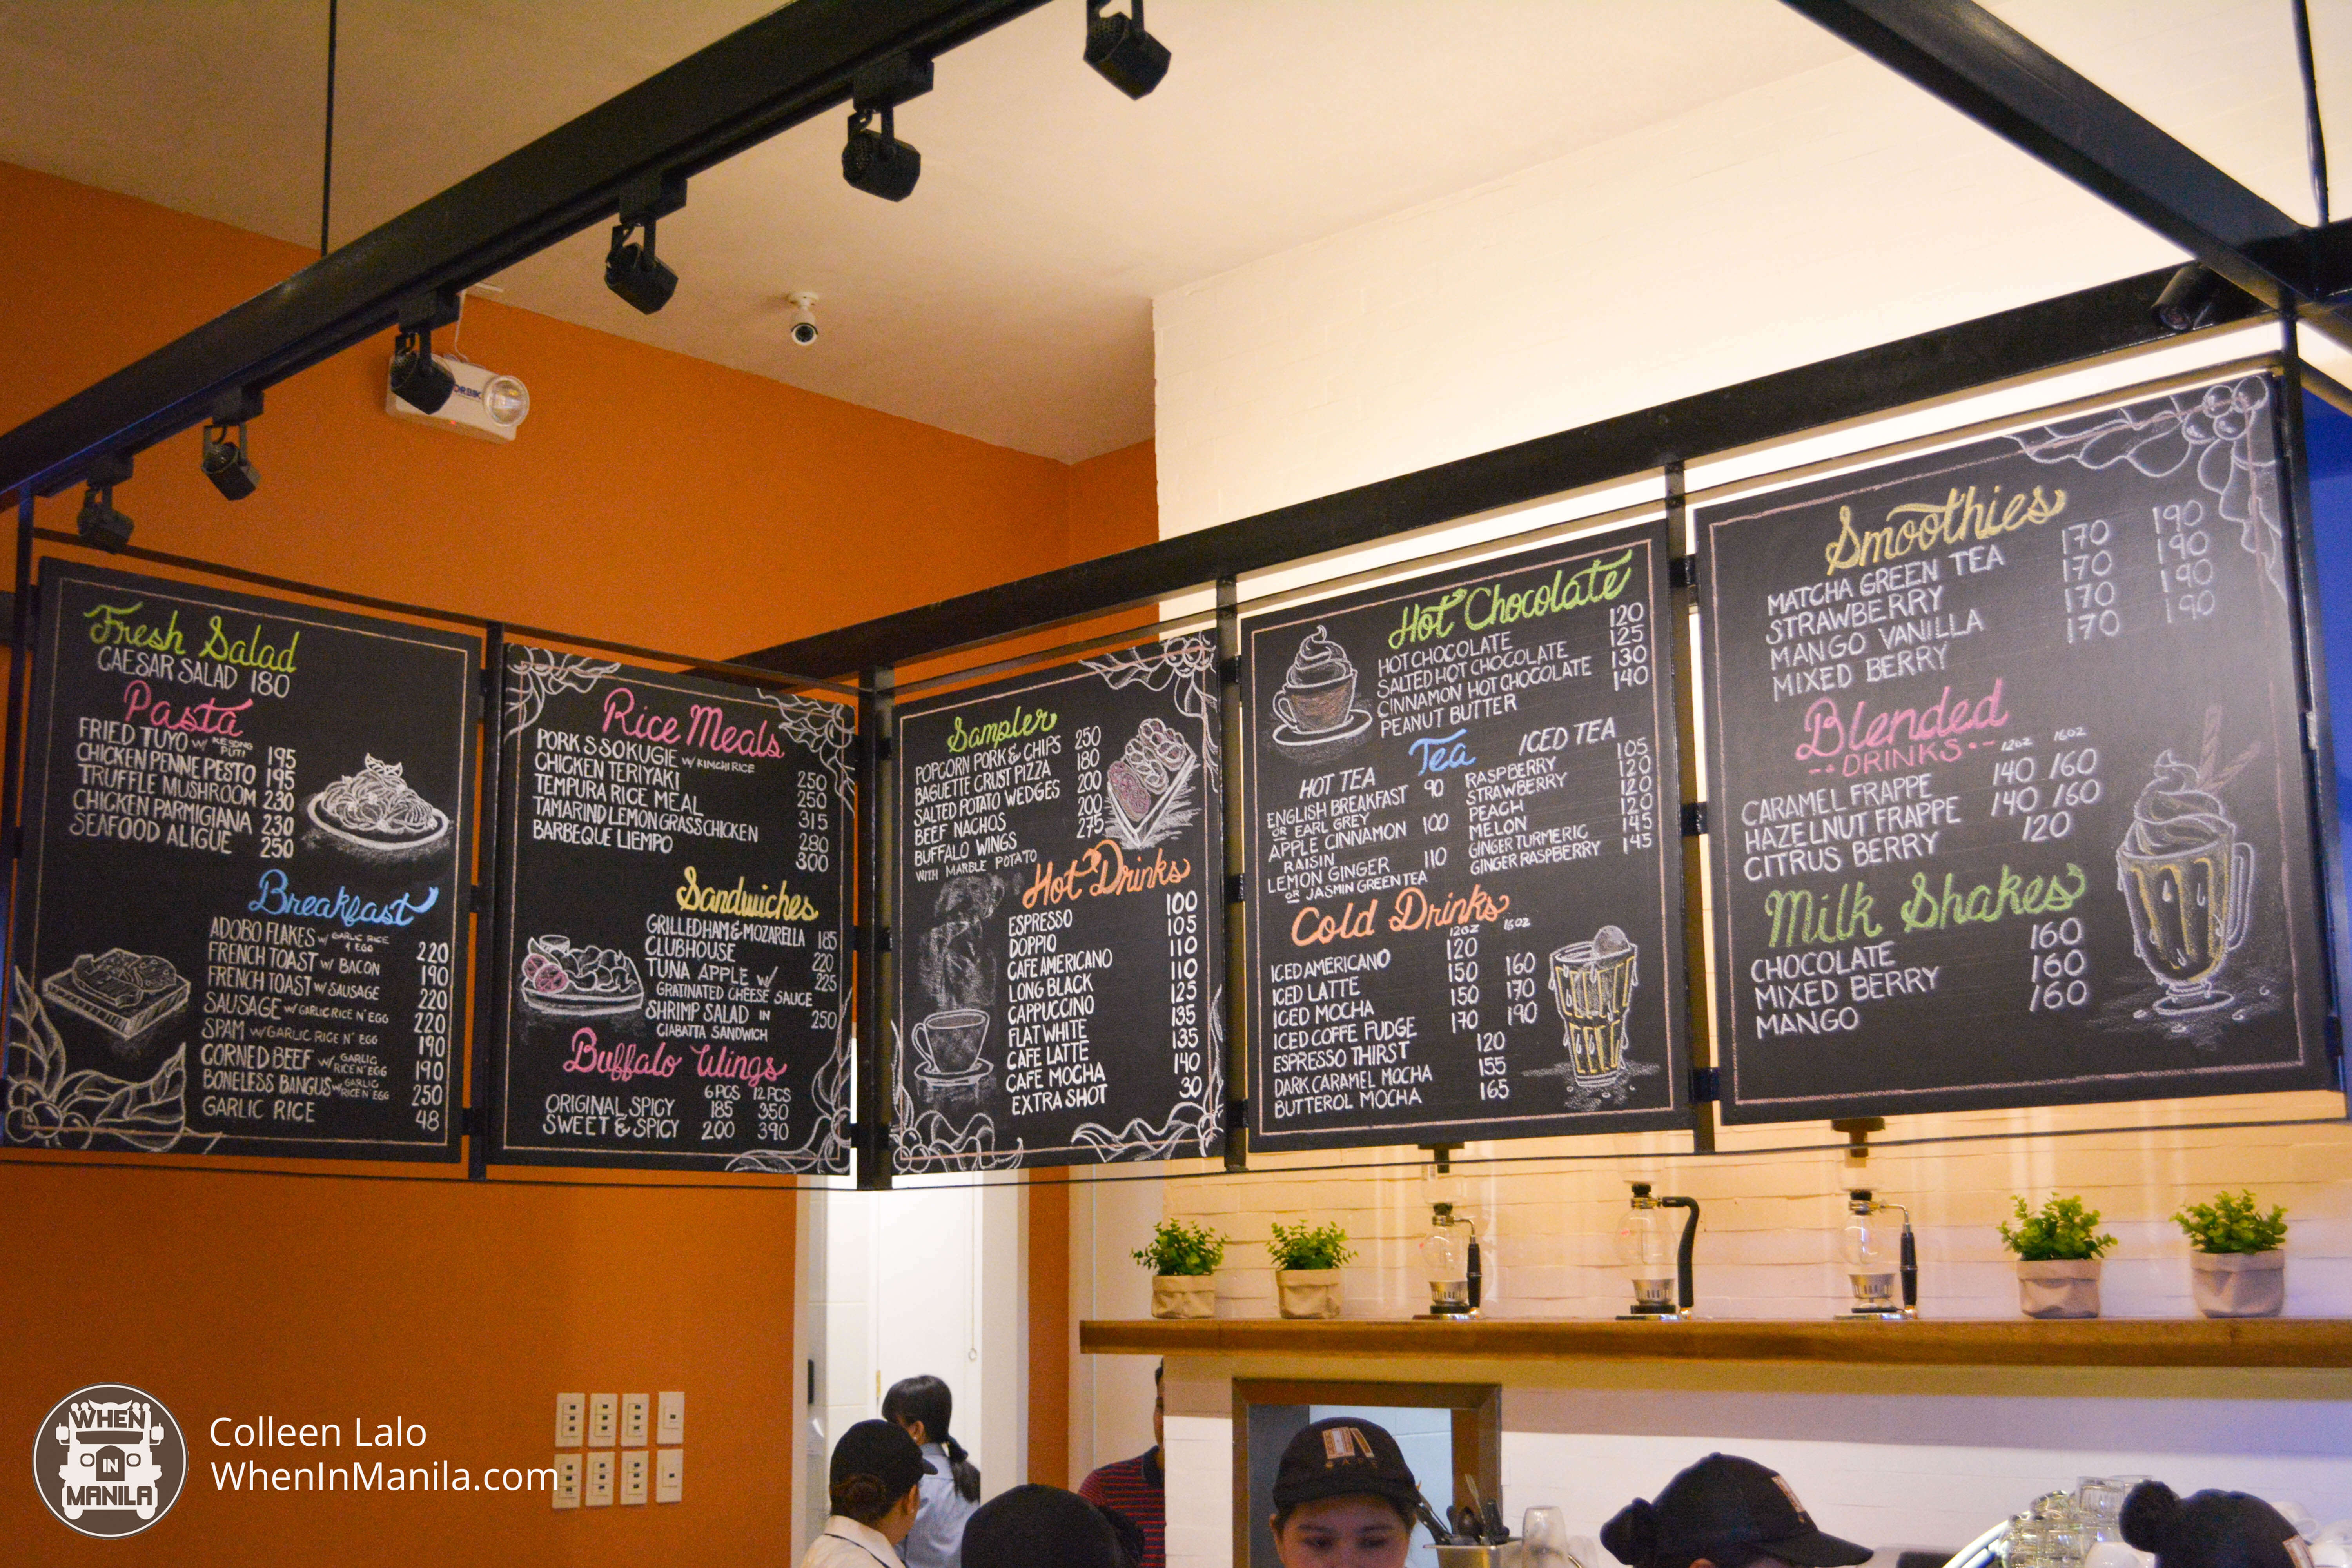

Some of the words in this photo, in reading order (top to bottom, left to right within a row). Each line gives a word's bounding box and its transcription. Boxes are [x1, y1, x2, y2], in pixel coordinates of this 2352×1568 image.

[1825, 486, 2066, 576] Smoothies
[1767, 579, 1853, 616] MATCHA
[1861, 559, 1938, 596] GREEN
[1949, 545, 2006, 576] TEA
[2062, 519, 2110, 554] 170
[2152, 499, 2203, 534] 190
[1388, 588, 1467, 649] Hot
[1464, 549, 1632, 631] Chocolate
[1769, 633, 1864, 671] MANGO
[1878, 608, 1984, 650] VANILLA
[2065, 582, 2116, 613] 170
[2160, 559, 2213, 593] 190
[84, 602, 186, 655] Fresh
[199, 615, 299, 673] Salad
[1378, 652, 1410, 678] HOT
[1412, 631, 1512, 668] CHOCOLATE
[1610, 602, 1644, 628] 120
[98, 646, 174, 681] CAESAR
[178, 658, 237, 690] SALAD
[250, 670, 290, 698] 180
[123, 679, 253, 737] Pasta
[602, 687, 681, 745] Rice
[686, 704, 784, 758] Meals
[1381, 708, 1444, 738] PEANUT
[1451, 694, 1517, 725] BUTTER
[1614, 667, 1648, 691] 140
[1795, 678, 2009, 760] Blended
[80, 717, 135, 745] FRIED
[140, 726, 188, 752] TUYO
[268, 746, 296, 769] 195
[947, 706, 1057, 753] Sampler
[1408, 728, 1477, 776] Tea
[1519, 727, 1568, 756] ICED
[1573, 717, 1616, 744] TEA
[77, 743, 147, 771] CHICKEN
[150, 751, 200, 780] PENNE
[204, 758, 256, 785] PESTO
[266, 768, 295, 790] 195
[535, 752, 604, 780] CHICKEN
[608, 762, 680, 791] TERIYAKI
[797, 790, 826, 810] 250
[537, 728, 580, 753] PORK
[731, 762, 754, 773] RICE
[797, 771, 826, 791] 250
[915, 776, 971, 807] BAGUETTE
[974, 767, 1012, 793] CRUST
[1015, 759, 1051, 784] PIZZA
[1077, 748, 1100, 771] 180
[1466, 772, 1567, 805] STRAWBERRY
[1619, 755, 1651, 777] 120
[1843, 738, 1962, 777] DRINKS
[78, 764, 157, 795] TRUFFLE
[163, 776, 256, 807] MUSHROOM
[263, 790, 294, 812] 230
[535, 773, 607, 803] TEMPURA
[611, 784, 647, 807] RICE
[655, 791, 704, 817] MEAL
[799, 811, 828, 831] 315
[1267, 803, 1326, 829] ENGLISH
[1331, 785, 1409, 817] BREAKFAST
[1424, 779, 1444, 798] 90
[69, 813, 160, 842] SEAFOOD
[167, 824, 232, 854] ALIGUE
[260, 837, 294, 858] 250
[915, 840, 969, 867] BUFFALO
[976, 831, 1017, 856] WINGS
[1076, 812, 1104, 839] 275
[1470, 816, 1527, 841] MELON
[1621, 793, 1653, 816] 120
[1745, 811, 1868, 854] HAZELNUT
[1876, 796, 1960, 834] FRAPPE
[1991, 786, 2038, 818] 140
[2052, 779, 2100, 808] 160
[915, 869, 938, 882] WITH
[946, 860, 987, 878] MARBLE
[995, 849, 1037, 870] POTATO
[1022, 848, 1102, 909] Hot
[1089, 839, 1191, 896] Drinks
[1284, 852, 1334, 873] RAISIN
[248, 869, 439, 927] Breakfast
[676, 866, 818, 921] Sandwiches
[1009, 909, 1073, 937] ESPRESSO
[1167, 890, 1197, 915] 100
[1292, 898, 1378, 947] Cold
[1389, 884, 1509, 932] Drinks
[1764, 881, 1882, 948] Milk
[1901, 863, 2086, 933] Shakes
[209, 941, 265, 965] FRENCH
[270, 947, 318, 972] TOAST
[340, 958, 379, 976] BACON
[421, 965, 449, 987] 190
[645, 936, 735, 963] CLUBHOUSE
[812, 952, 833, 973] 220
[1751, 941, 1895, 983] CHOCOLATE
[2029, 917, 2082, 950] 160
[656, 982, 724, 1001] GRATINATED
[729, 985, 769, 1005] CHEESE
[774, 990, 812, 1007] SAUCE
[1008, 995, 1094, 1025] CAPPUCCINO
[1171, 980, 1196, 1004] 125
[1009, 981, 1044, 1003] LONG
[1047, 973, 1093, 998] BLACK
[1171, 958, 1198, 980] 110
[1274, 985, 1303, 1007] ICED
[1308, 976, 1361, 1002] LATTE
[1448, 962, 1478, 982] 150
[1506, 952, 1535, 976] 160
[657, 1022, 706, 1039] CIABATTA
[711, 1026, 767, 1042] SANDWICH
[1009, 1025, 1041, 1048] FLAT
[1042, 1019, 1088, 1043] WHITE
[1172, 1004, 1196, 1027] 135
[1756, 1007, 1858, 1039] MANGO
[2029, 980, 2087, 1012] 160
[202, 1018, 244, 1041] SPAM
[267, 1026, 312, 1041] GARLIC
[315, 1032, 338, 1044] RICE
[360, 1034, 378, 1045] EGG
[419, 1036, 445, 1057] 190
[563, 1027, 682, 1082] Buffalo
[690, 1044, 787, 1087] Wings
[1012, 1091, 1062, 1116] EXTRA
[1065, 1084, 1107, 1108] SHOT
[1179, 1076, 1202, 1098] 30
[1274, 1075, 1310, 1098] DARK
[1313, 1070, 1375, 1094] CARAMEL
[1381, 1065, 1432, 1086] MOCHA
[1479, 1057, 1506, 1077] 155
[203, 1096, 264, 1118] GARLIC
[274, 1099, 315, 1122] RICE
[416, 1110, 439, 1131] 48
[543, 1115, 610, 1136] SWEET
[634, 1118, 679, 1138] SPICY
[702, 1120, 735, 1140] 200
[758, 1122, 788, 1140] 390
